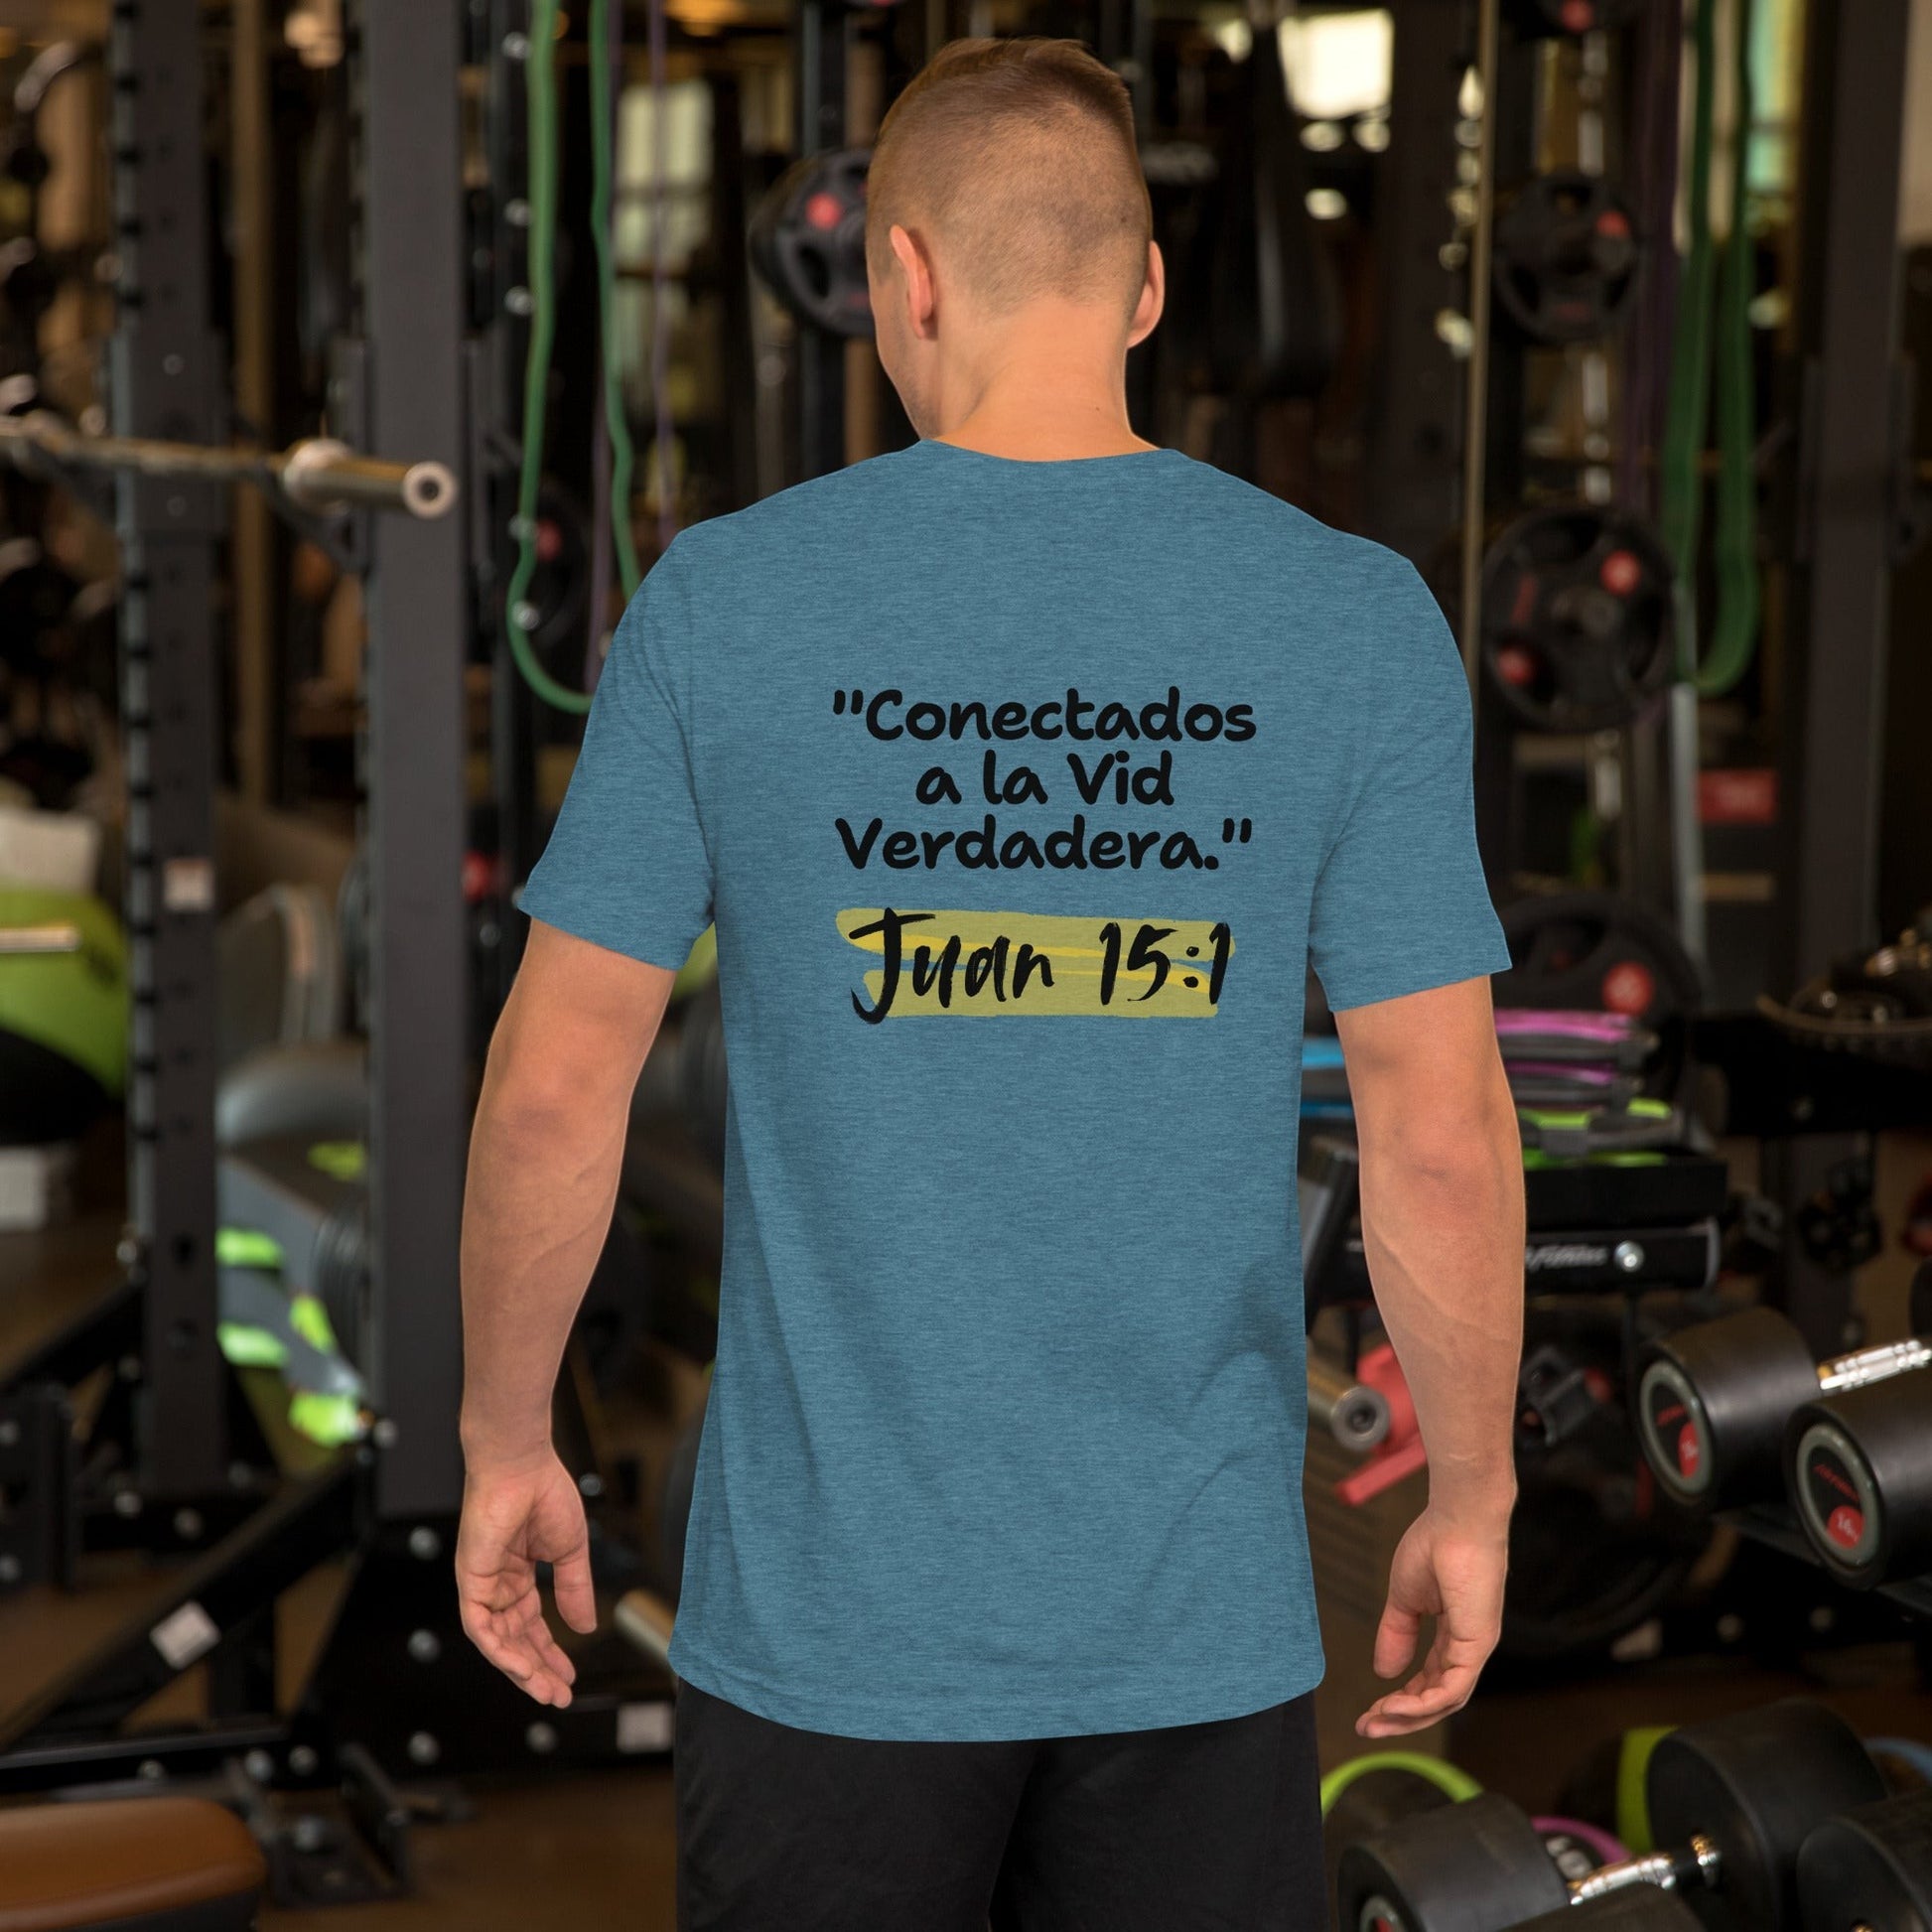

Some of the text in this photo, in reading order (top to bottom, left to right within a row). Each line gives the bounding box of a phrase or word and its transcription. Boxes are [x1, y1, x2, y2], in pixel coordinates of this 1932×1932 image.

[832, 685, 1258, 743] "Conectados
[915, 749, 1175, 806] a la Vid
[834, 813, 1254, 871] Verdadera."
[848, 906, 1232, 1026] Juan 15:1
